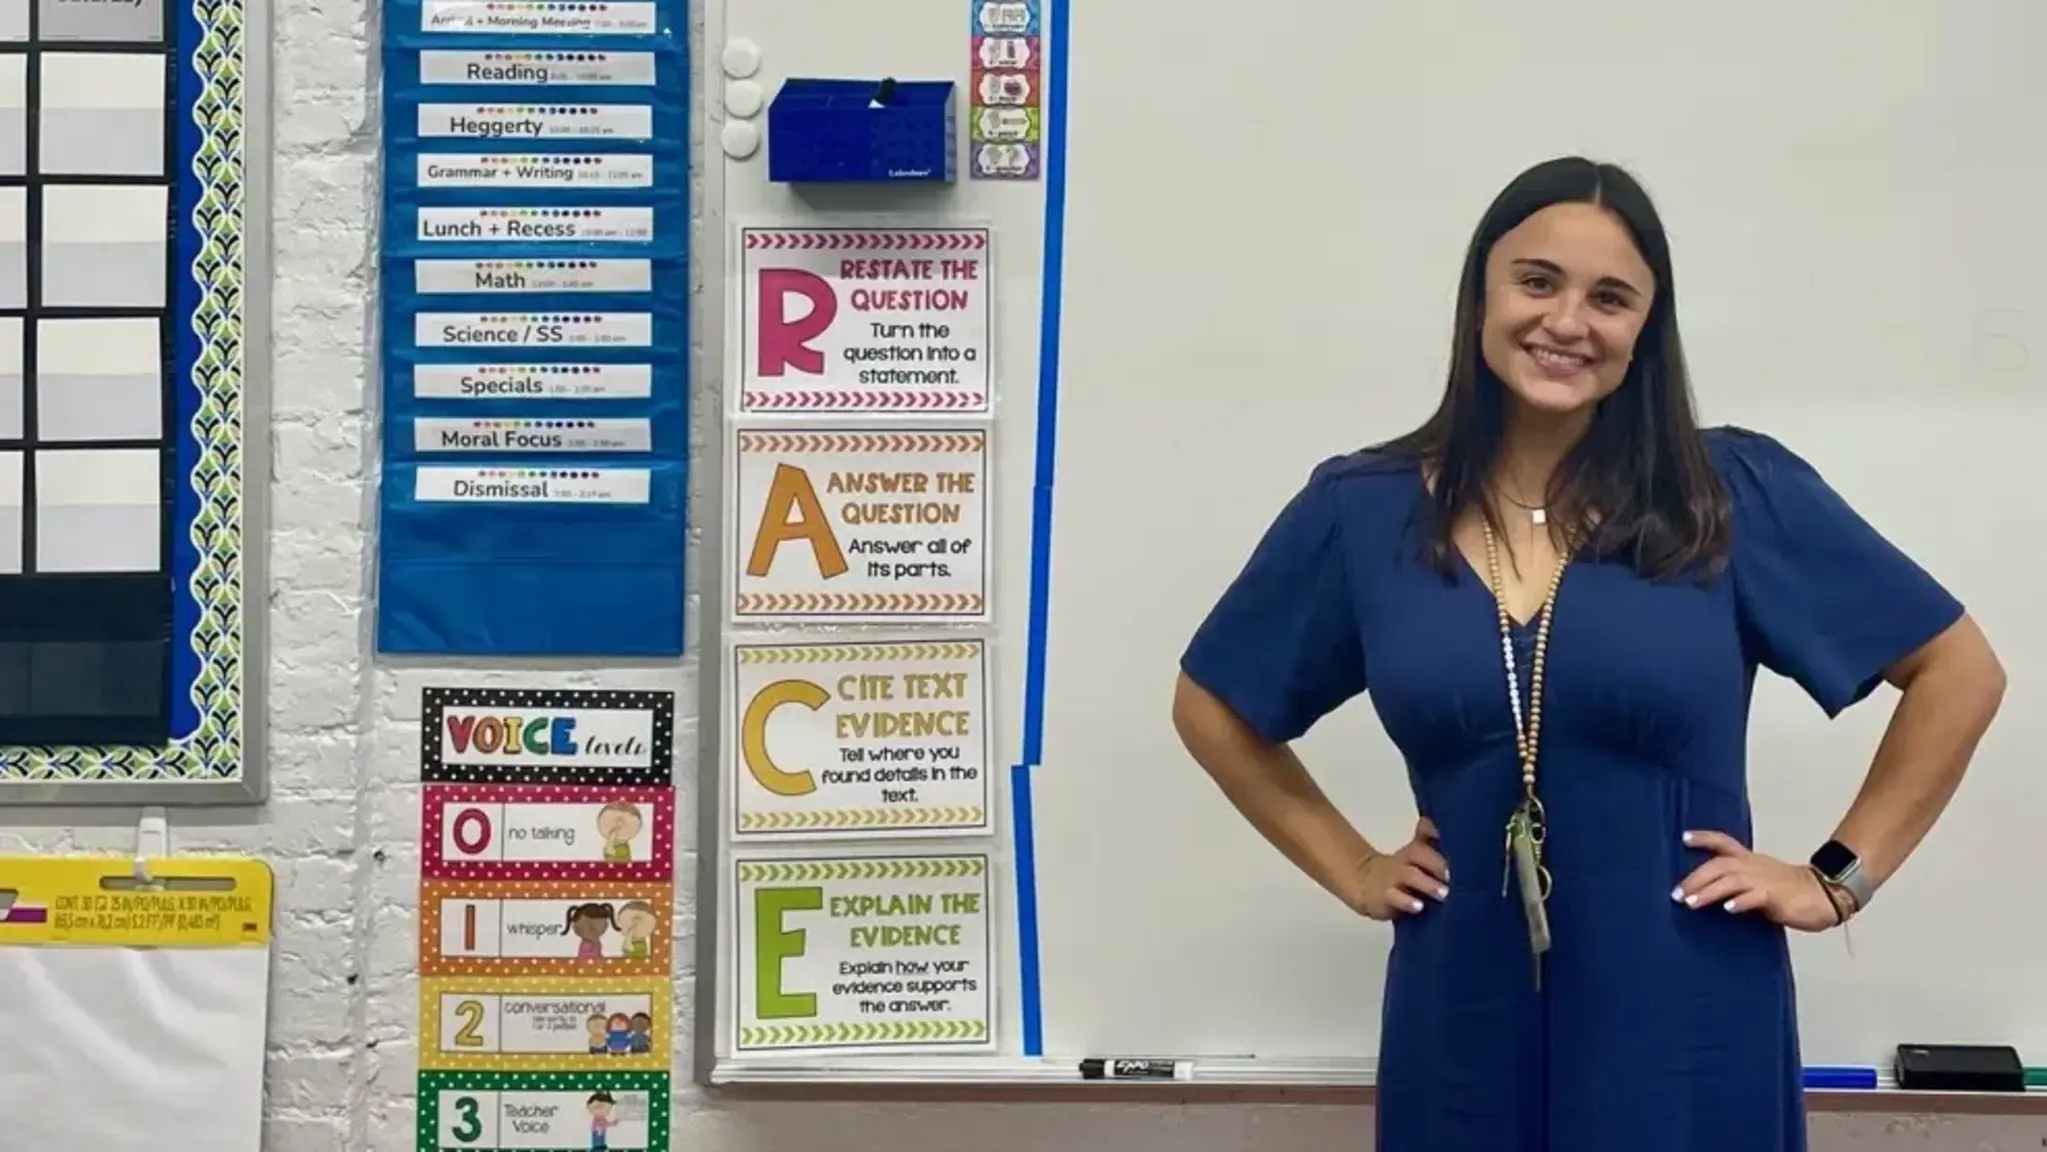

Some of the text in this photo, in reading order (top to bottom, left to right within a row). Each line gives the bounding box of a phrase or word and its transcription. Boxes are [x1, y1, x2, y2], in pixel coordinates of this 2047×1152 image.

[430, 14, 473, 26] Arral
[488, 15, 538, 29] Morning
[467, 63, 548, 83] Reading
[450, 116, 543, 136] Heggerty
[428, 165, 497, 179] Grammar
[503, 168, 512, 177] +
[517, 164, 574, 181] Writing
[423, 220, 482, 237] Lunch
[489, 223, 501, 235] +
[507, 220, 575, 237] Recess
[840, 259, 978, 280] RESTATE THE
[475, 272, 526, 289] Math
[851, 289, 968, 311] QUESTION
[758, 268, 838, 377] R
[870, 322, 950, 338] Turn the
[443, 326, 518, 343] Science
[522, 327, 531, 343] /
[536, 326, 563, 342] SS
[843, 346, 976, 362] question into a
[859, 369, 959, 384] statement.
[460, 377, 543, 396] Specials
[441, 432, 499, 447] Moral
[505, 431, 562, 447] Focus
[453, 480, 548, 498] Dismissal
[826, 472, 976, 494] ANSWER THE
[747, 462, 849, 580] A
[841, 502, 961, 525] QUESTION
[849, 539, 972, 554] Answer all of
[895, 563, 953, 580] parts.
[837, 673, 969, 701] CITE TEXT
[836, 711, 970, 739] EVIDENCE
[447, 716, 646, 756] VOICE levels
[742, 679, 832, 797] C
[840, 746, 961, 763] Tell where you
[822, 766, 978, 784] found details in the
[881, 789, 918, 803] text.
[509, 825, 576, 846] no talking
[830, 893, 980, 917] EXPLAIN THE
[507, 924, 564, 940] whisper
[851, 925, 961, 947] EVIDENCE
[755, 886, 823, 1019] E
[839, 959, 969, 976] Explain how your
[832, 978, 977, 995] evidence supports
[504, 1001, 606, 1014] conversational
[859, 999, 950, 1013] the answer.
[454, 1000, 484, 1047] 2
[451, 1096, 483, 1143] 3
[503, 1104, 559, 1117] Teacher
[512, 1121, 550, 1134] Voice
